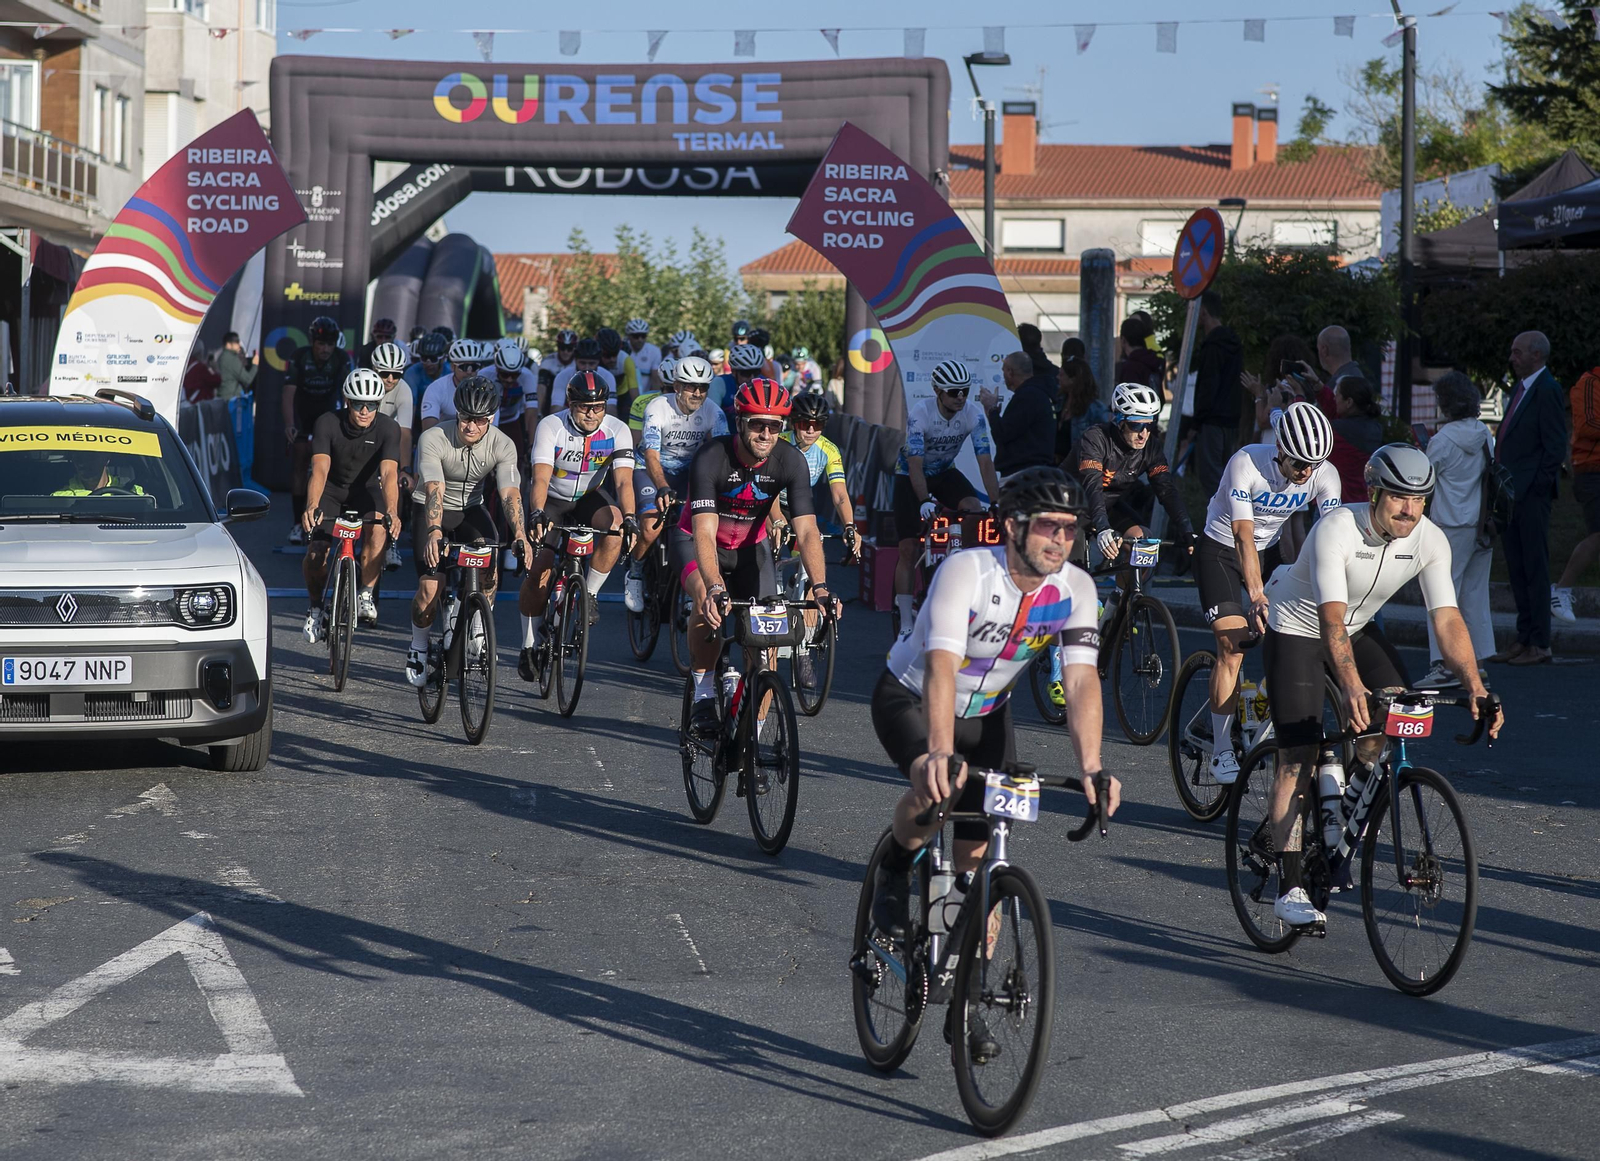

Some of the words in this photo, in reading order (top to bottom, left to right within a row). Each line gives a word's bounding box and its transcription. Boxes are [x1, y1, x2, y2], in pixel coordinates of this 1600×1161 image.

[433, 72, 783, 124] OURENSE
[673, 131, 784, 151] TERMAL
[187, 148, 273, 165] RIBEIRA
[187, 171, 261, 188] SACRA
[825, 164, 909, 181] RIBEIRA
[187, 194, 280, 211] CYCLING
[824, 187, 897, 204] SACRA
[187, 217, 249, 234] ROAD
[823, 209, 915, 227] CYCLING
[823, 233, 884, 249] ROAD
[299, 292, 340, 300] DEPORTE
[154, 334, 173, 344] OU
[56, 432, 132, 445] MÉDICO
[691, 499, 716, 510] 26ERS
[1252, 491, 1307, 508] ADN
[339, 529, 356, 539] 156
[574, 545, 587, 555] 41
[464, 557, 484, 567] 155
[1136, 555, 1154, 565] 264
[758, 620, 782, 633] 257
[20, 661, 76, 681] 9047
[85, 660, 126, 681] NNP
[1396, 722, 1425, 736] 186
[993, 794, 1031, 817] 246
